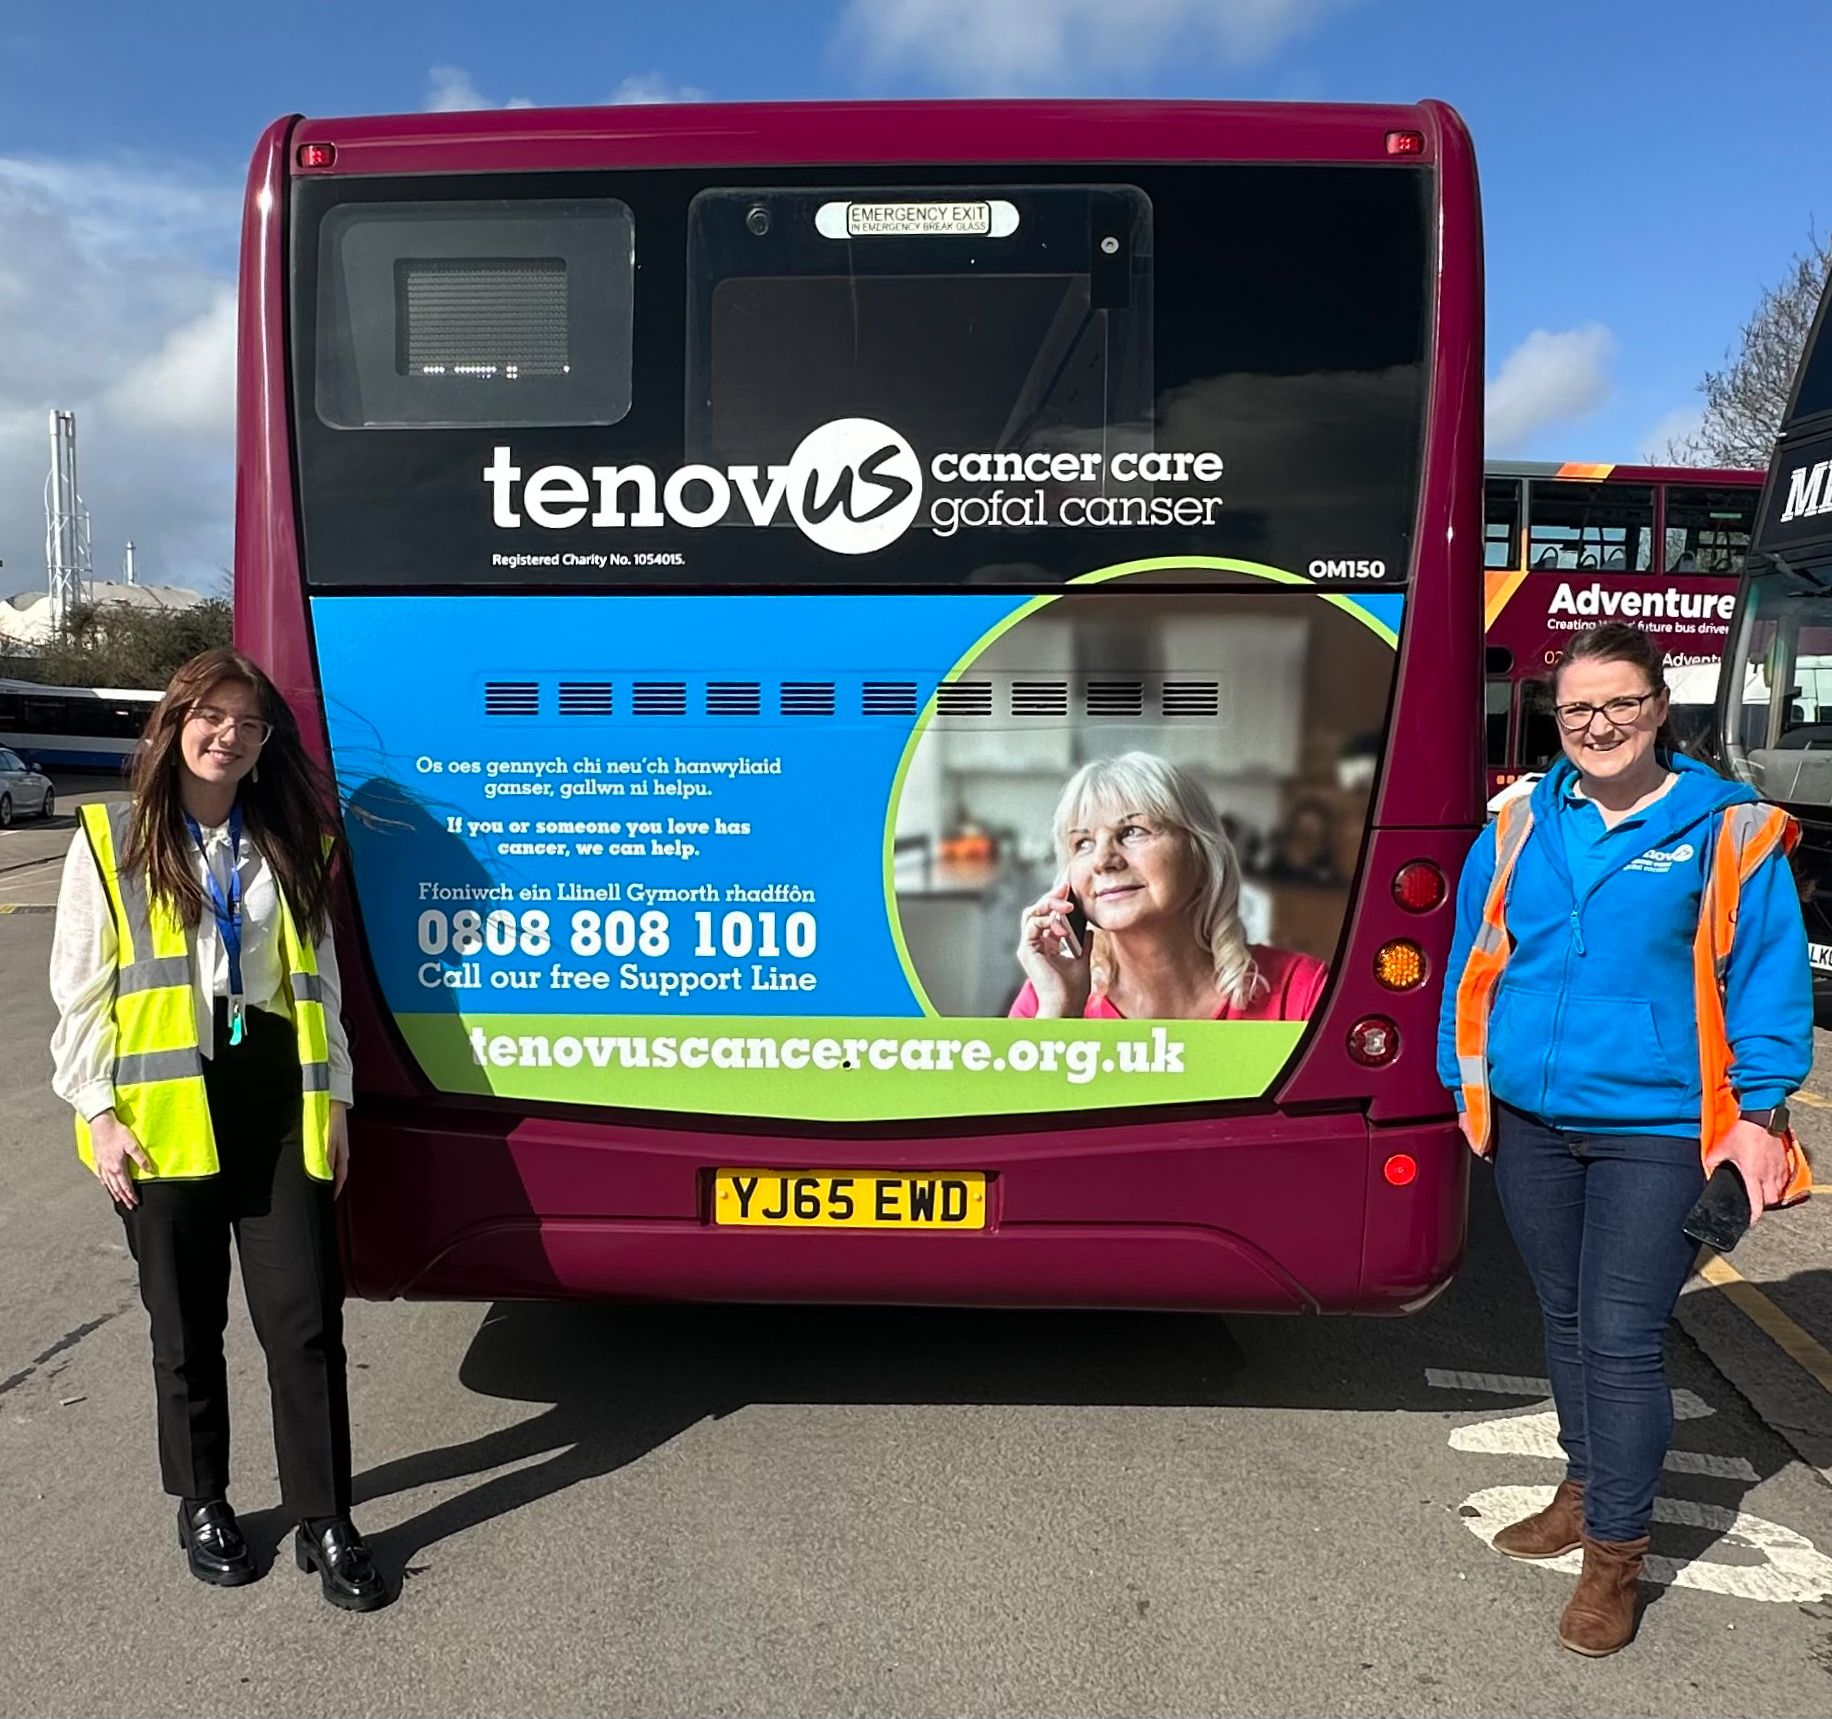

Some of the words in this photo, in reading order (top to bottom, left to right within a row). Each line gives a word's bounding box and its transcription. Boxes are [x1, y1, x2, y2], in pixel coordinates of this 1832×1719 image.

[851, 206, 947, 222] EMERGENCY
[952, 206, 985, 220] EXIT
[851, 224, 860, 232] IN
[862, 223, 920, 232] EMERGENCY
[923, 222, 953, 231] BREAK
[956, 221, 986, 231] GLASS
[930, 452, 1103, 482] cancer
[1111, 452, 1224, 482] care
[483, 446, 914, 530] tenovus
[930, 489, 1049, 537] gofal
[1059, 494, 1224, 527] canser
[492, 553, 560, 569] Registered
[562, 553, 608, 569] Charity
[610, 553, 632, 566] No.
[634, 553, 686, 566] 1054015.
[1308, 560, 1386, 579] OM150
[1547, 582, 1736, 620] Adventure
[1675, 622, 1696, 633] bus
[415, 755, 444, 774] Os
[447, 761, 482, 774] oes
[485, 756, 569, 778] gennych
[572, 756, 602, 774] chi
[606, 757, 670, 774] neu'ch
[674, 756, 782, 778] hanwyliaid
[484, 782, 554, 799] ganser,
[559, 778, 626, 800] gallwn
[629, 779, 649, 796] ni
[653, 778, 713, 800] helpu.
[446, 816, 463, 834] If
[466, 821, 504, 838] you
[508, 821, 531, 834] or
[535, 821, 622, 835] someone
[625, 821, 663, 838] you
[667, 817, 710, 835] love
[714, 817, 751, 835] has
[497, 843, 571, 857] cancer,
[575, 843, 604, 856] we
[608, 843, 647, 856] can
[650, 838, 700, 860] help.
[418, 882, 514, 902] Ffoniwch
[518, 883, 552, 901] ein
[556, 882, 621, 902] Llinell
[626, 882, 721, 906] Gymorth
[725, 883, 816, 904] rhadffôn
[417, 909, 551, 957] 0808
[570, 909, 670, 957] 808
[694, 910, 817, 958] 1010
[417, 962, 481, 989] Call
[490, 970, 542, 989] our
[549, 963, 610, 990] free
[619, 963, 742, 997] Support
[751, 964, 817, 991] Line
[470, 1026, 1186, 1084] tenovuscancercare.org.uk
[731, 1176, 854, 1220] YJ65
[875, 1179, 968, 1222] EWD
